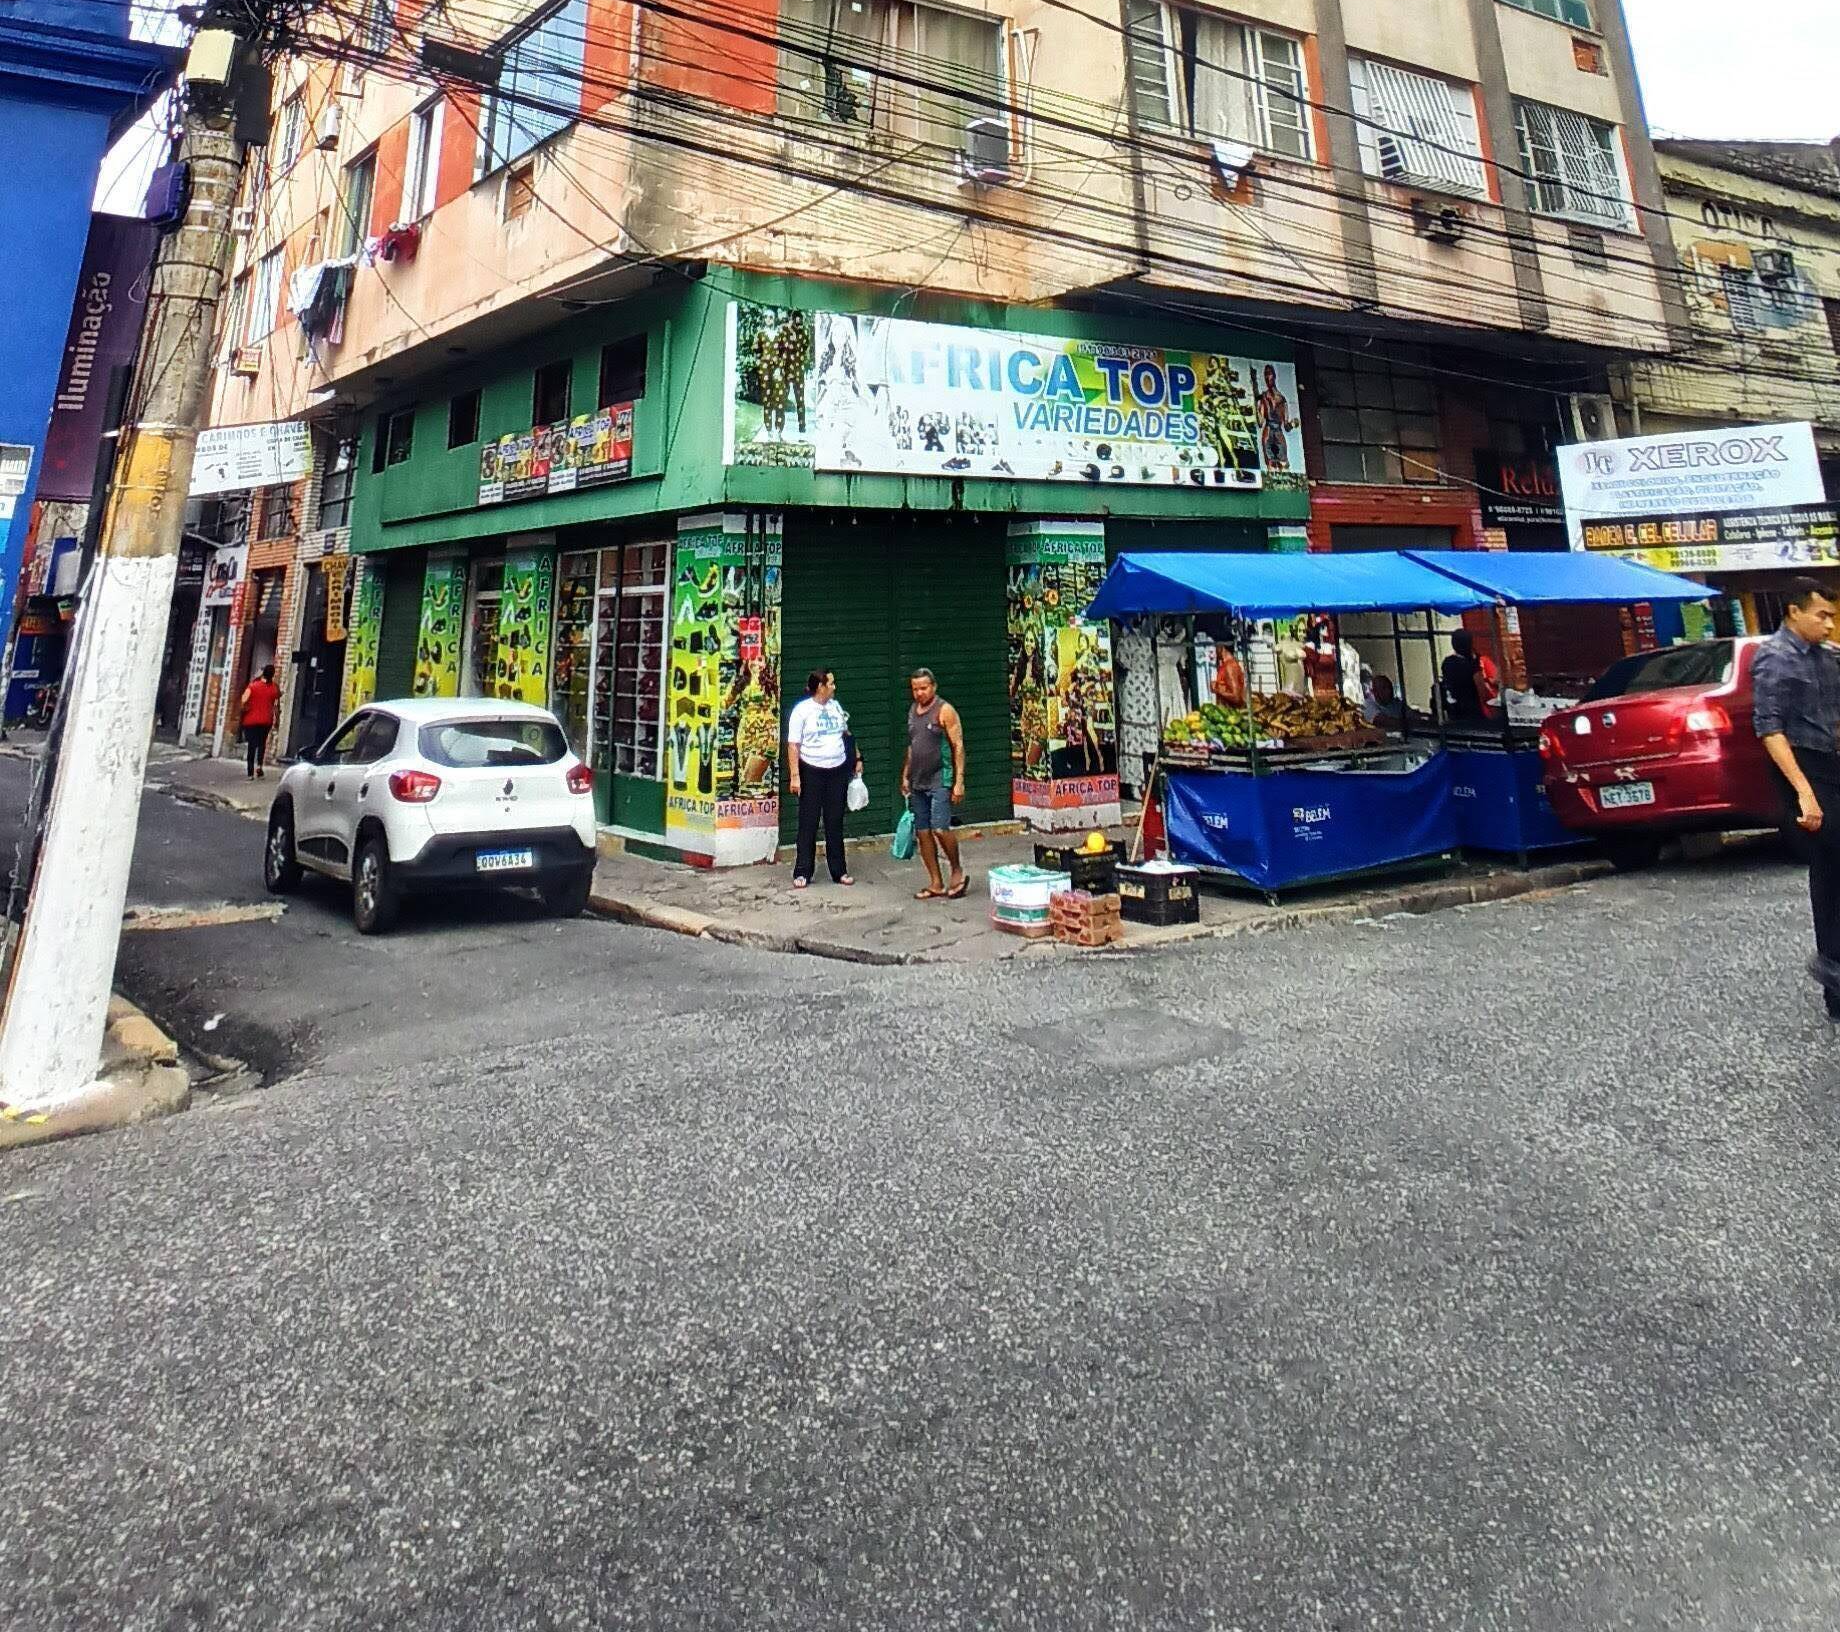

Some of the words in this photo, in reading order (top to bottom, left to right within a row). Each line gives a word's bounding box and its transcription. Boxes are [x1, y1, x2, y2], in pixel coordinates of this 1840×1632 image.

[57, 272, 111, 410] Iluminação
[1096, 356, 1197, 408] TOP
[1012, 401, 1200, 441] VARIEDADES
[1628, 435, 1789, 472] XEROX
[1096, 778, 1117, 792] TOP
[699, 799, 716, 816] TOP
[756, 800, 778, 815] TOP
